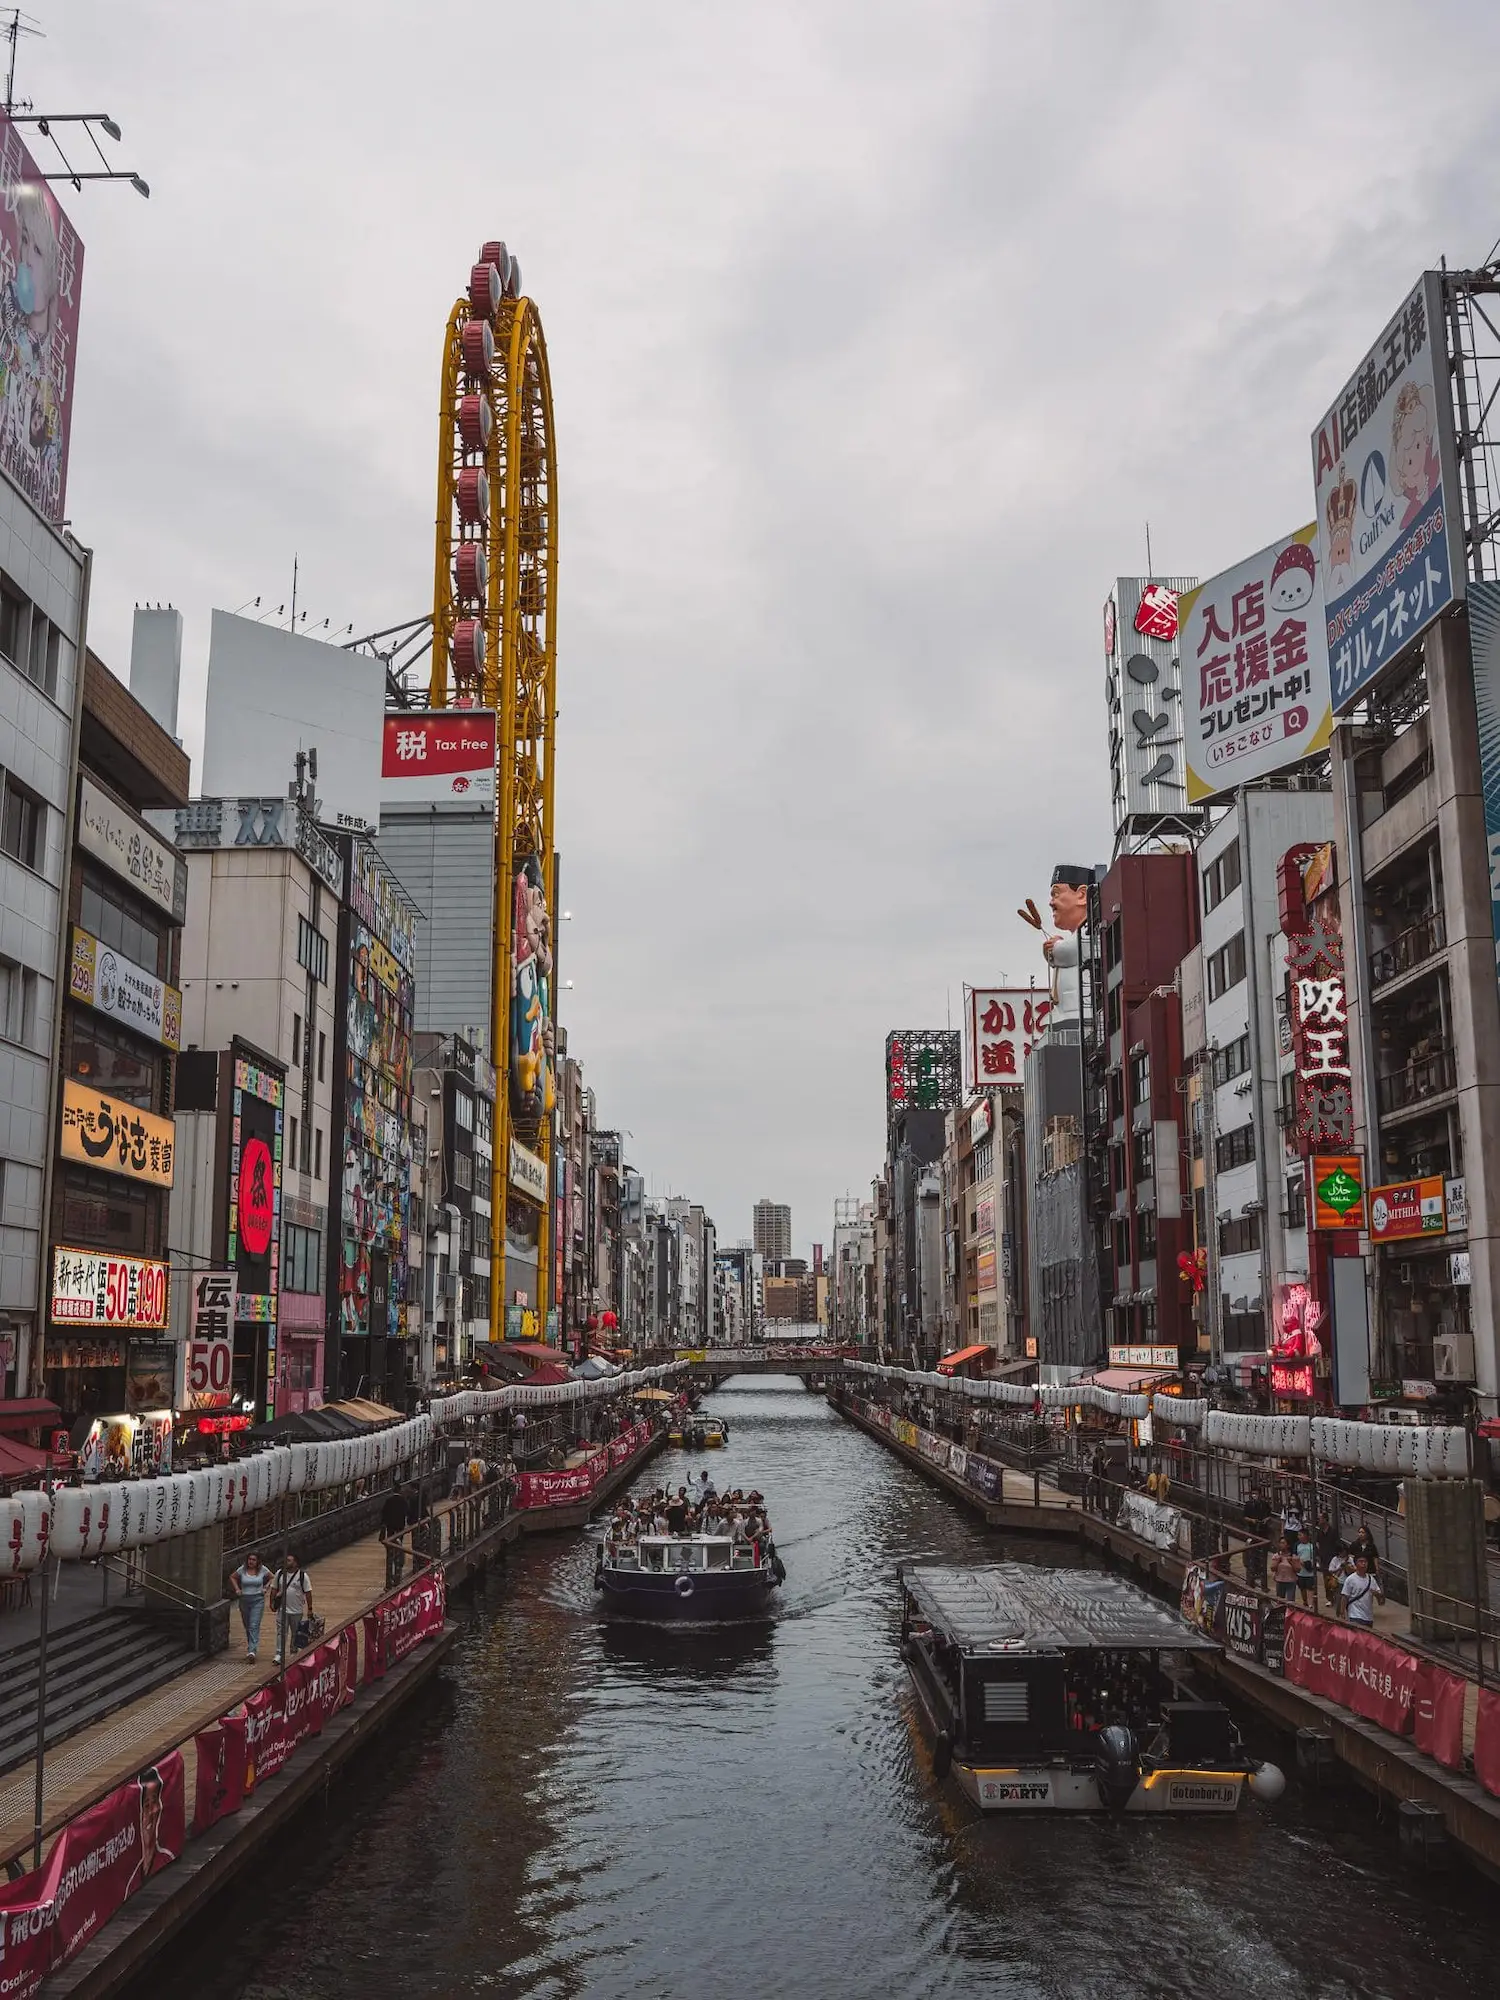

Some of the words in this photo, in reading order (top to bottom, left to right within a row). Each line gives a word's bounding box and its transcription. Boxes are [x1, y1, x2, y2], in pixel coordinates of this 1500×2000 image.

[1317, 290, 1427, 486] AI店舗の王様
[1197, 579, 1266, 658] 入店
[1335, 556, 1443, 696] ガルフネット
[1199, 616, 1308, 711] 応援金
[1199, 667, 1311, 740] プレゼント中!
[396, 731, 428, 760] 税
[435, 740, 457, 751] Tax
[461, 739, 489, 750] Free
[1212, 722, 1273, 761] いちごなび
[1284, 920, 1354, 1144] 大阪王将
[80, 1100, 148, 1170] うなぎ
[1387, 1205, 1420, 1220] MITHILA
[58, 1256, 97, 1296] 新時代
[106, 1263, 128, 1321] 50
[136, 1266, 166, 1323] 190
[195, 1277, 231, 1342] 伝串
[190, 1344, 231, 1391] 50
[154, 1486, 165, 1535] コクミン
[999, 1788, 1049, 1800] PARTY
[1172, 1786, 1234, 1802] dotonbori.jp
